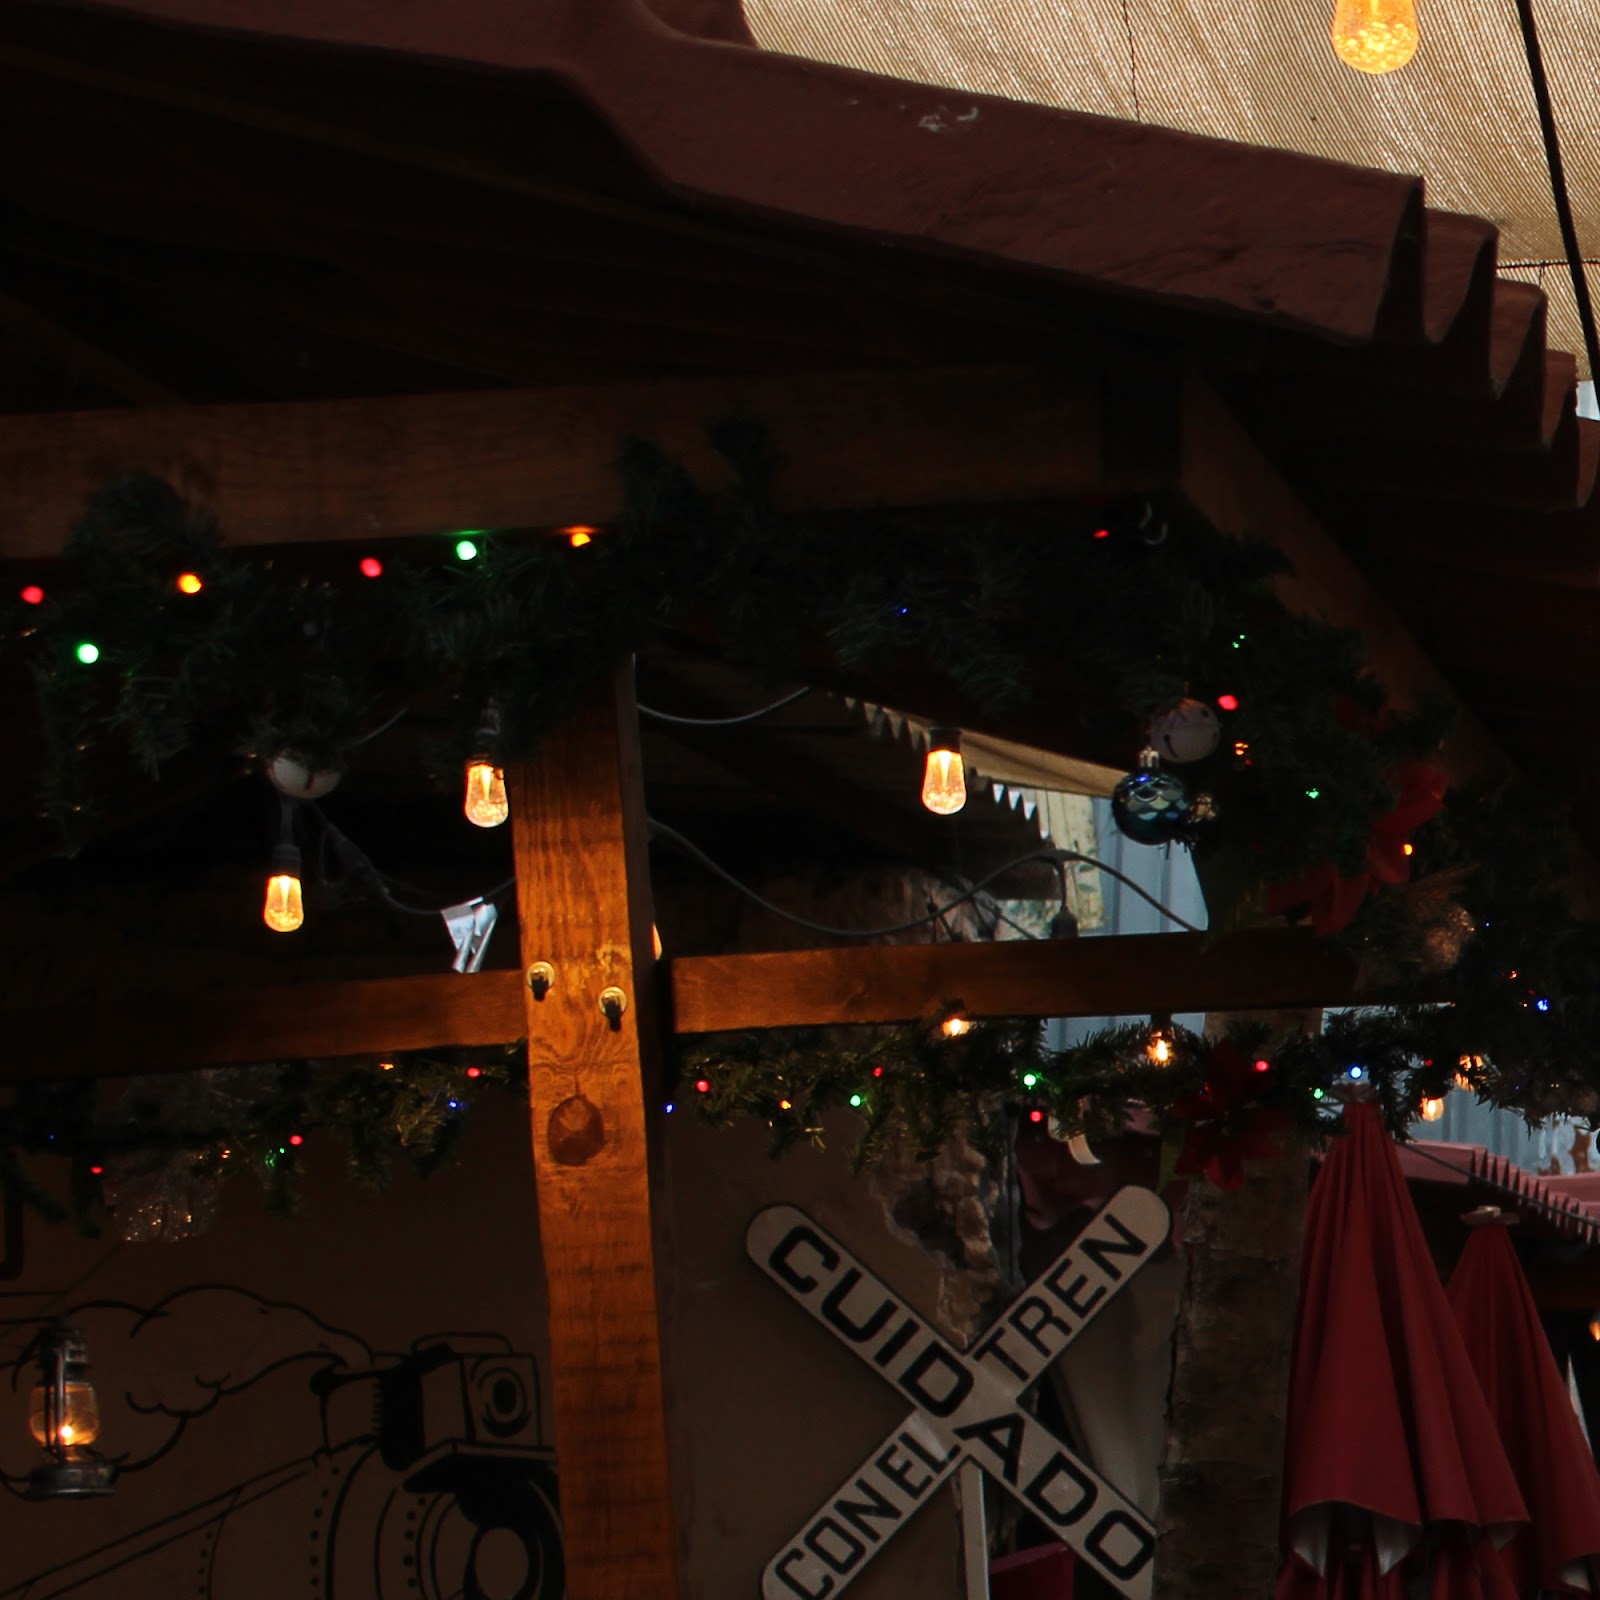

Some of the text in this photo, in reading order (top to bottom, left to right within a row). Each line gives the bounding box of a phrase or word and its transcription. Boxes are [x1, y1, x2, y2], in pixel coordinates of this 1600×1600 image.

[768, 1226, 1155, 1580] CUIDADO
[875, 1431, 961, 1499] EL
[974, 1213, 1147, 1382] TREN
